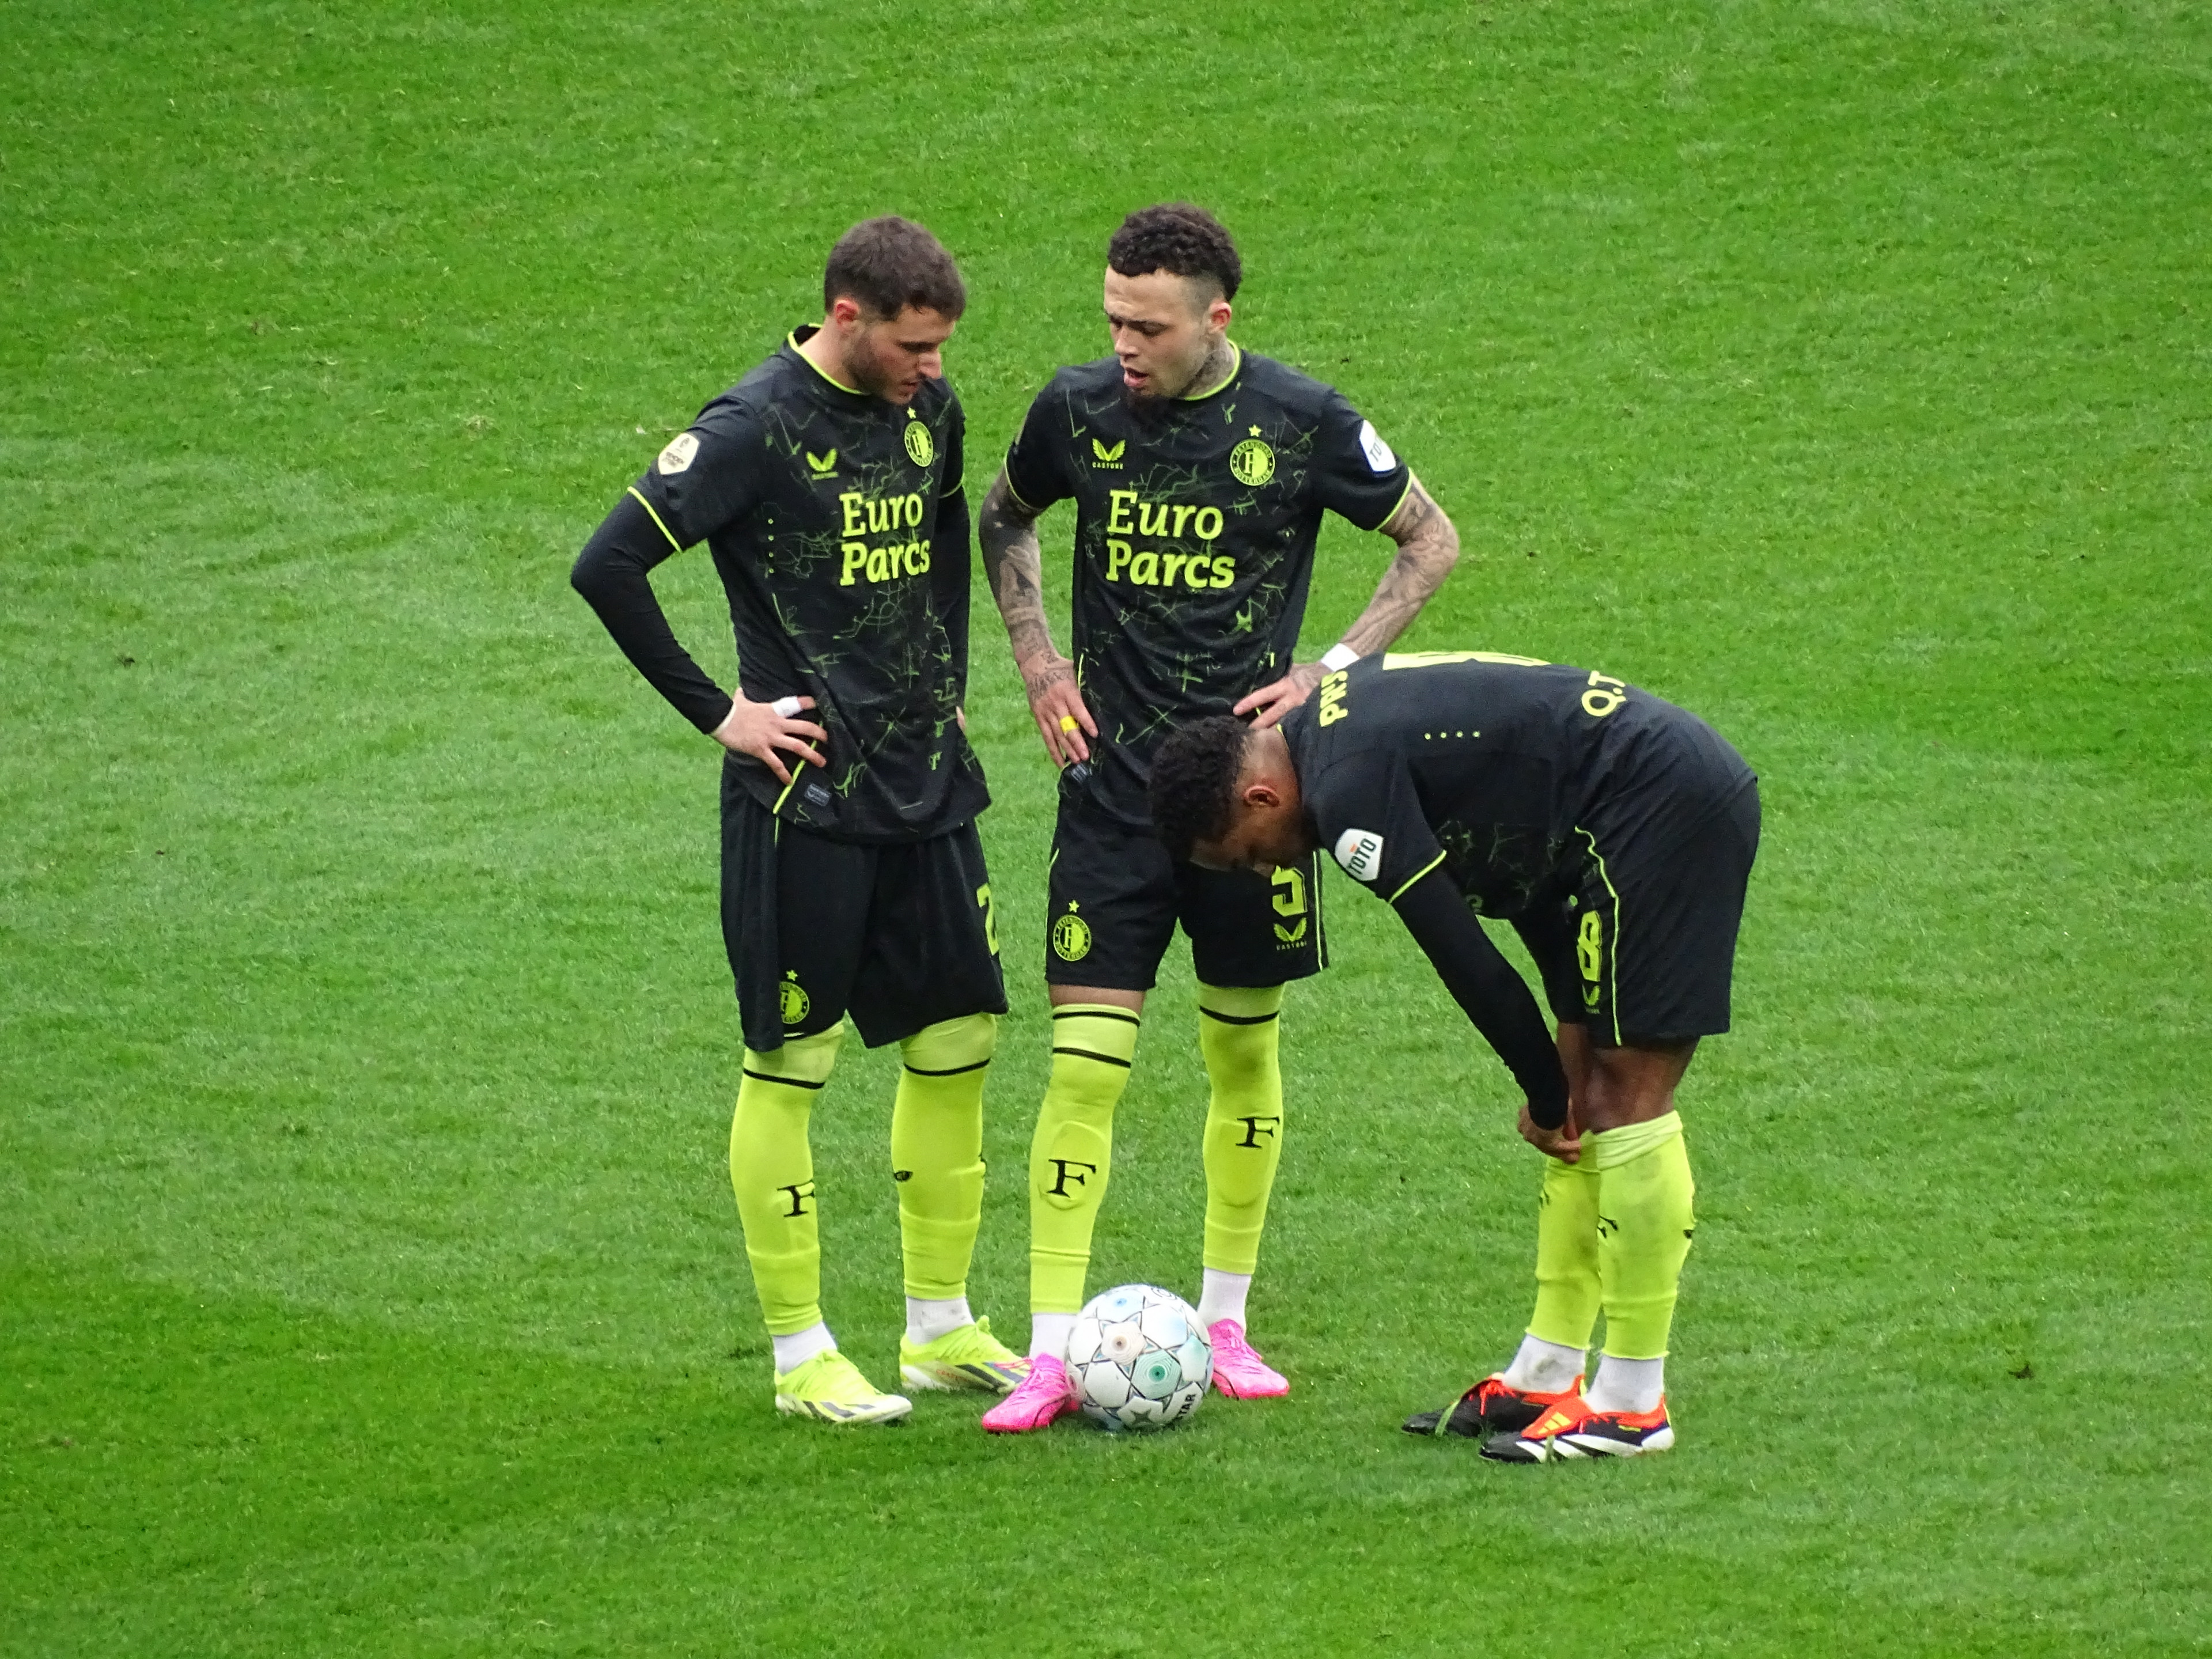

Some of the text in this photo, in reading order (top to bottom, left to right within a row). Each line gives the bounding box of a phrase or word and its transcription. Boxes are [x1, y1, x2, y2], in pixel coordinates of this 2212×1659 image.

[839, 493, 923, 537] Euro
[1107, 489, 1224, 540] Euro
[840, 540, 931, 586] Parcs
[1105, 539, 1236, 589] Parcs
[1347, 838, 1376, 875] TOTO
[1577, 910, 1602, 982] 8
[1236, 1116, 1280, 1149] F
[1047, 1159, 1096, 1198] F
